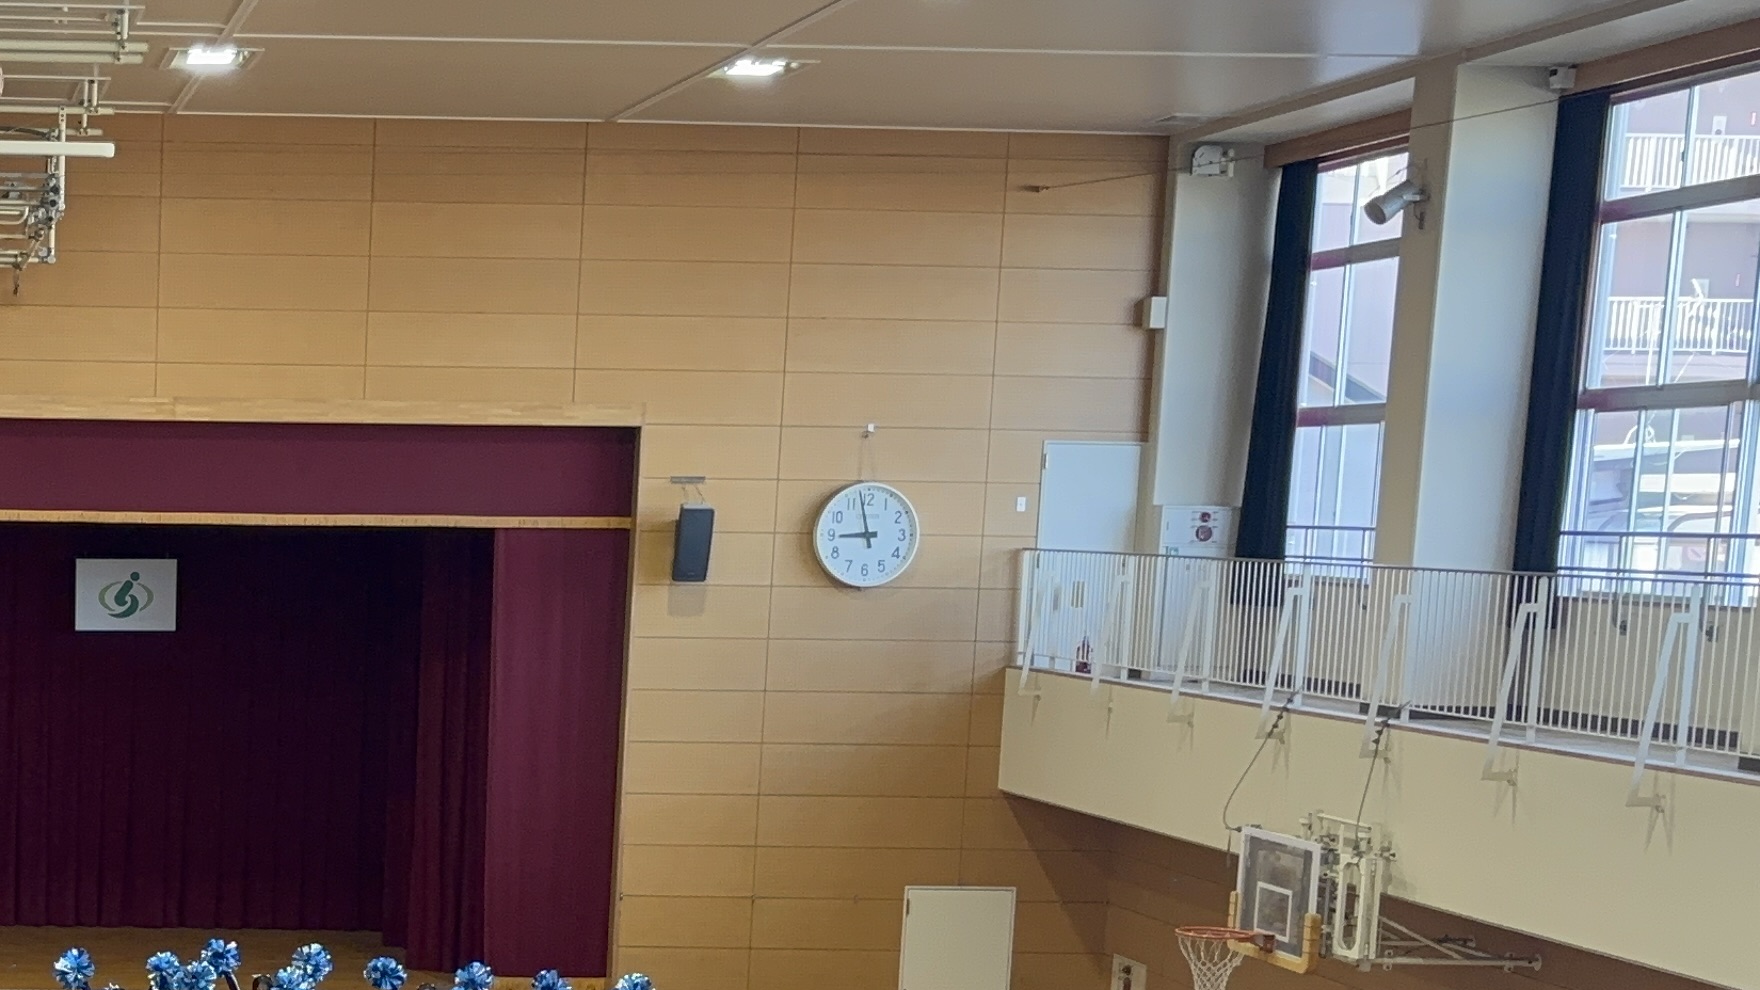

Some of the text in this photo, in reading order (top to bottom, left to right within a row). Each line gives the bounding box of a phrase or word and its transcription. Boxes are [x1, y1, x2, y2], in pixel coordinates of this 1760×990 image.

[847, 498, 856, 511] 11
[831, 511, 843, 524] 10
[894, 511, 903, 524] 2
[827, 529, 836, 541] 9
[897, 529, 906, 541] 3
[830, 546, 840, 559] 8
[891, 546, 900, 559] 4
[845, 560, 853, 573] 7
[860, 563, 869, 576] 6
[877, 560, 886, 573] 5
